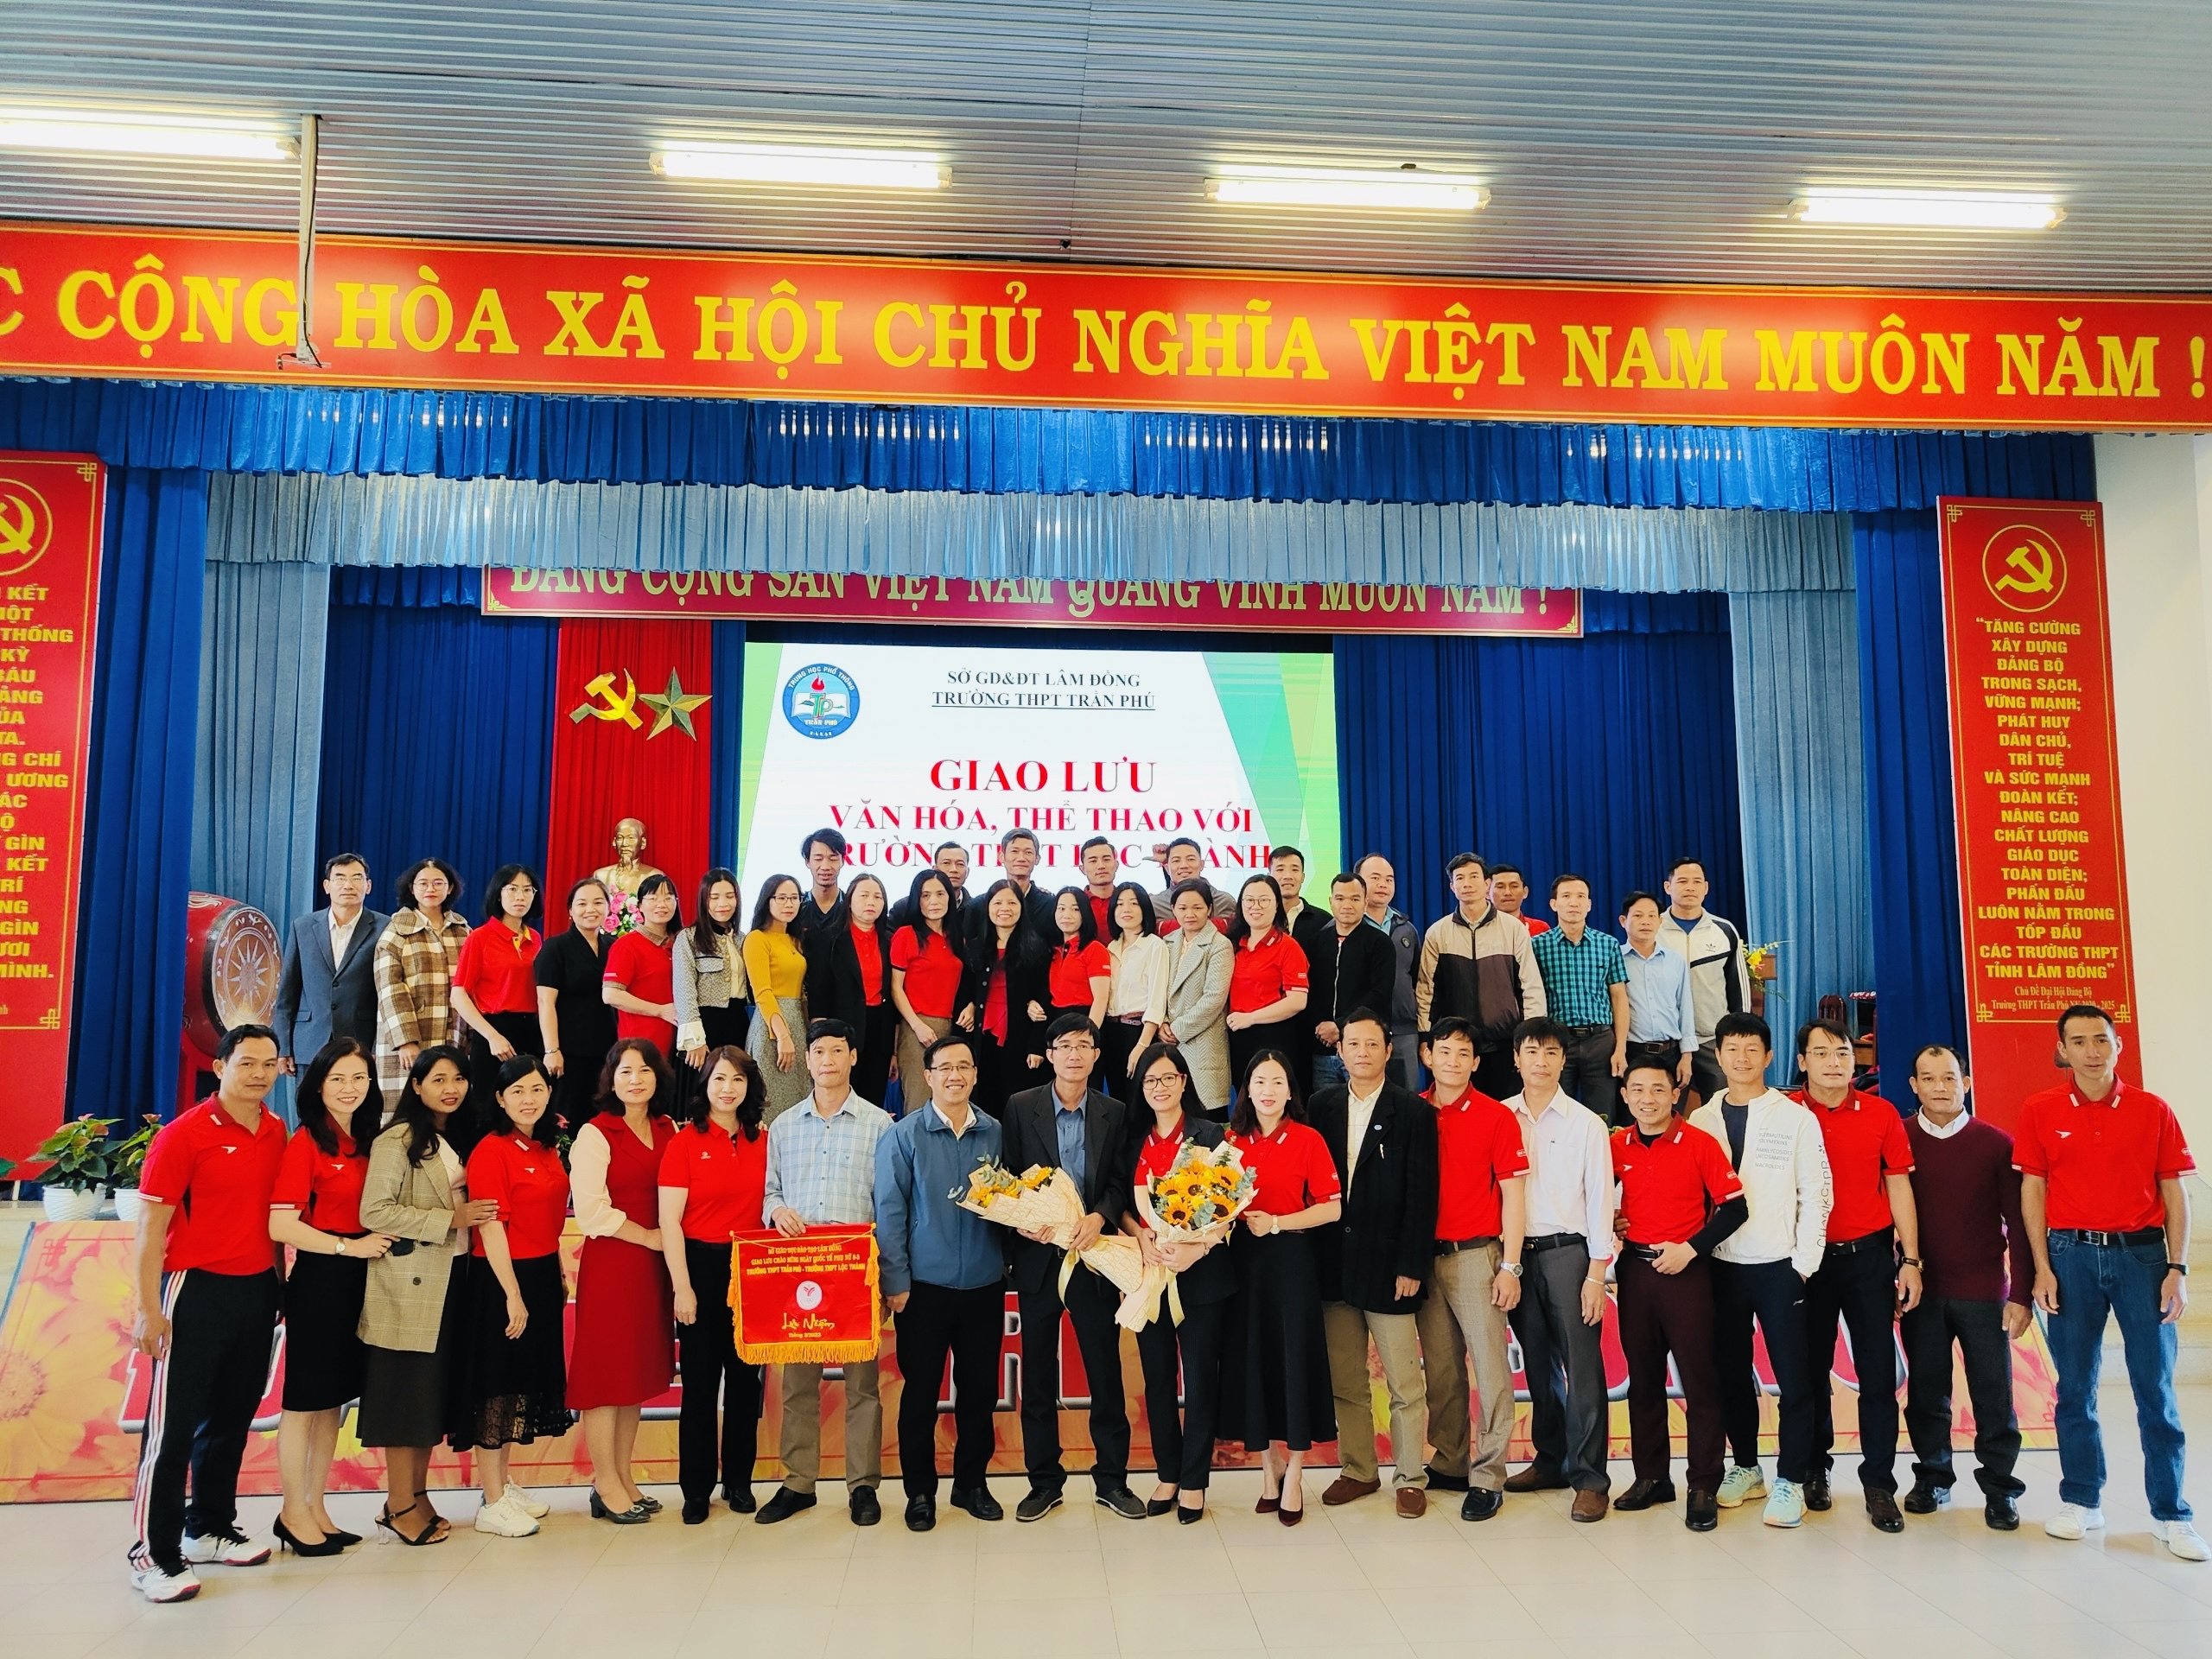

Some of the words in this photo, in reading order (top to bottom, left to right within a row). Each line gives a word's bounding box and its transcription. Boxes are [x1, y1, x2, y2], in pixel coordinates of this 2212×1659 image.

[58, 254, 301, 359] CỘNG
[335, 264, 519, 353] HÒA
[544, 276, 665, 359] XÃ
[694, 278, 843, 380] HỘI
[874, 281, 1042, 372] CHỦ
[1074, 299, 1329, 380] NGHĨA
[1350, 302, 1535, 400] VIỆT
[1562, 326, 1729, 391] NAM
[1755, 312, 1969, 395] MUÔN
[1997, 316, 2160, 398] NĂM
[2189, 336, 2205, 398] !
[7, 583, 49, 601] KẾT
[968, 578, 1053, 603] NAM
[1216, 580, 1306, 610] VINH
[0, 624, 73, 642] THỐNG
[2029, 620, 2081, 635] CƯỜNG
[0, 646, 30, 662] KỲ
[1992, 637, 2020, 652] XÂY
[2026, 639, 2067, 655] DỰNG
[1997, 655, 2039, 671] ĐẢNG
[2044, 658, 2063, 675] BỘ
[788, 671, 807, 689] TRUNG
[838, 672, 855, 690] THÔNG
[976, 671, 1039, 685] GD&ĐT
[1045, 669, 1083, 686] LÂM
[1981, 677, 2031, 690] TRONG
[2037, 678, 2082, 693] SẠCH,
[932, 689, 1010, 706] TRƯỜNG
[1015, 693, 1061, 706] THPT
[1121, 690, 1155, 708] PHÚ
[1984, 693, 2025, 709] VỮNG
[2031, 697, 2081, 712] MẠNH;
[1997, 713, 2036, 727] PHÁT
[2041, 716, 2070, 728] HUY
[1999, 733, 2031, 747] DÂN
[2036, 731, 2071, 749] CHỦ,
[23, 750, 61, 766] CHÍ
[2008, 751, 2032, 766] TRÍ
[2037, 751, 2064, 769] TUỆ
[6, 772, 68, 788] ƯƠNG
[930, 759, 1048, 791] GIAO
[1061, 756, 1157, 793] LƯU
[1984, 770, 2005, 784] VÀ
[2009, 770, 2040, 785] SỨC
[2045, 772, 2090, 789] MẠNH
[1999, 790, 2042, 804] ĐOÀN
[2047, 788, 2078, 806] KẾT;
[829, 798, 903, 830] VĂN
[912, 799, 998, 836] HÓA,
[1087, 808, 1183, 832] THAO
[1192, 801, 1253, 832] VỚI
[2001, 809, 2044, 823] NÂNG
[2049, 810, 2079, 824] CAO
[5, 834, 45, 850] GÌN
[1994, 825, 2034, 842] CHẤT
[2038, 828, 2089, 845] LƯỢNG
[843, 836, 933, 867] RƯỜN
[971, 843, 1062, 868] TT
[2007, 846, 2042, 862] GIÁO
[2048, 849, 2079, 865] DỤC
[7, 853, 48, 871] KẾT
[2001, 866, 2042, 881] TOÀN
[2047, 867, 2088, 884] DIỆN;
[2006, 883, 2049, 899] PHẤN
[2054, 883, 2085, 900] ĐẤU
[1978, 904, 2020, 919] LUÔN
[2024, 902, 2061, 920] NẰM
[2065, 908, 2114, 920] TRONG
[0, 918, 39, 935] GÌN
[2016, 921, 2046, 939] TỐP
[2050, 922, 2082, 939] ĐẦU
[1979, 943, 2012, 959] CÁC
[2016, 944, 2078, 959] TRƯỜNG
[2082, 947, 2118, 959] THPT
[1985, 962, 2022, 978] TỈNH
[2027, 963, 2061, 978] LÂM
[2018, 1000, 2038, 1010] THPT
